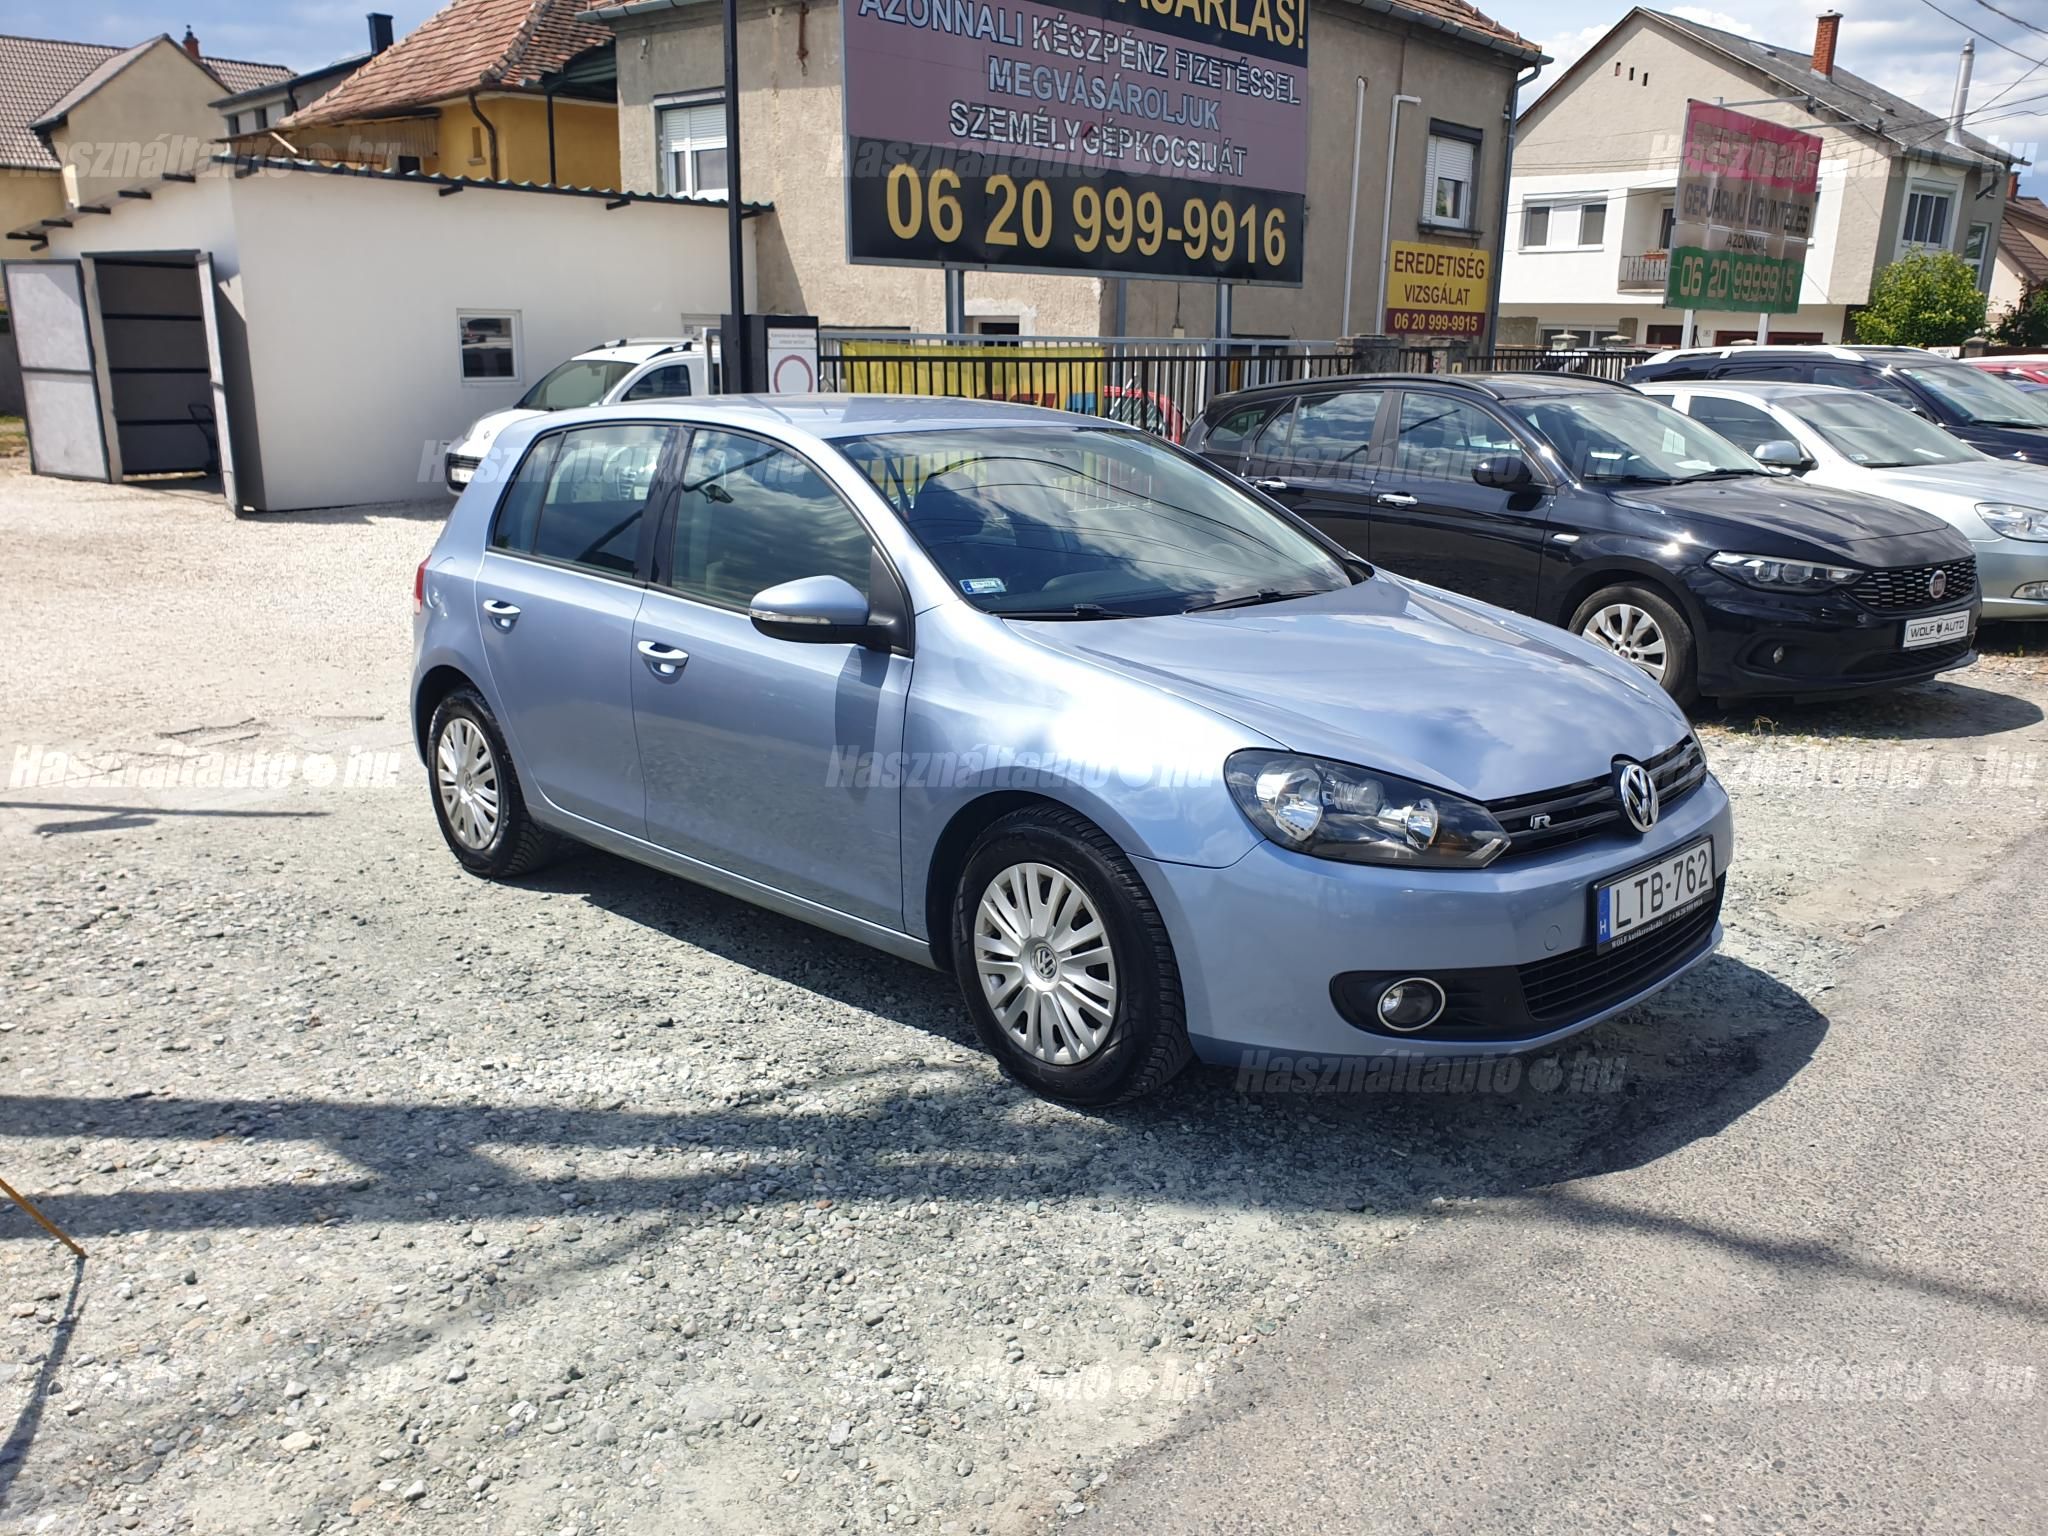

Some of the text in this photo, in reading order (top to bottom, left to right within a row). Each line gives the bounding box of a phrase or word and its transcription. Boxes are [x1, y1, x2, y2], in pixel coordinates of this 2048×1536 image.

[1032, 14, 1168, 78] KÉSZPÉNZ
[1175, 48, 1301, 105] FIZETÉSSEL
[988, 55, 1221, 131] MEGVÁSÁROLJUK
[949, 100, 1248, 176] SZEMÉLYGÉPKOCSIJÁT
[886, 163, 1287, 267] 06 20 999-9916
[1394, 250, 1485, 279] EREDETISÉG
[1404, 283, 1470, 305] VIZSGÁLAT
[1679, 255, 1704, 297] 06
[1707, 258, 1729, 298] 20
[1394, 312, 1478, 331] 06 20 999-9915
[1910, 620, 1965, 638] WOLF AUTO
[1616, 849, 1708, 929] LTB-762
